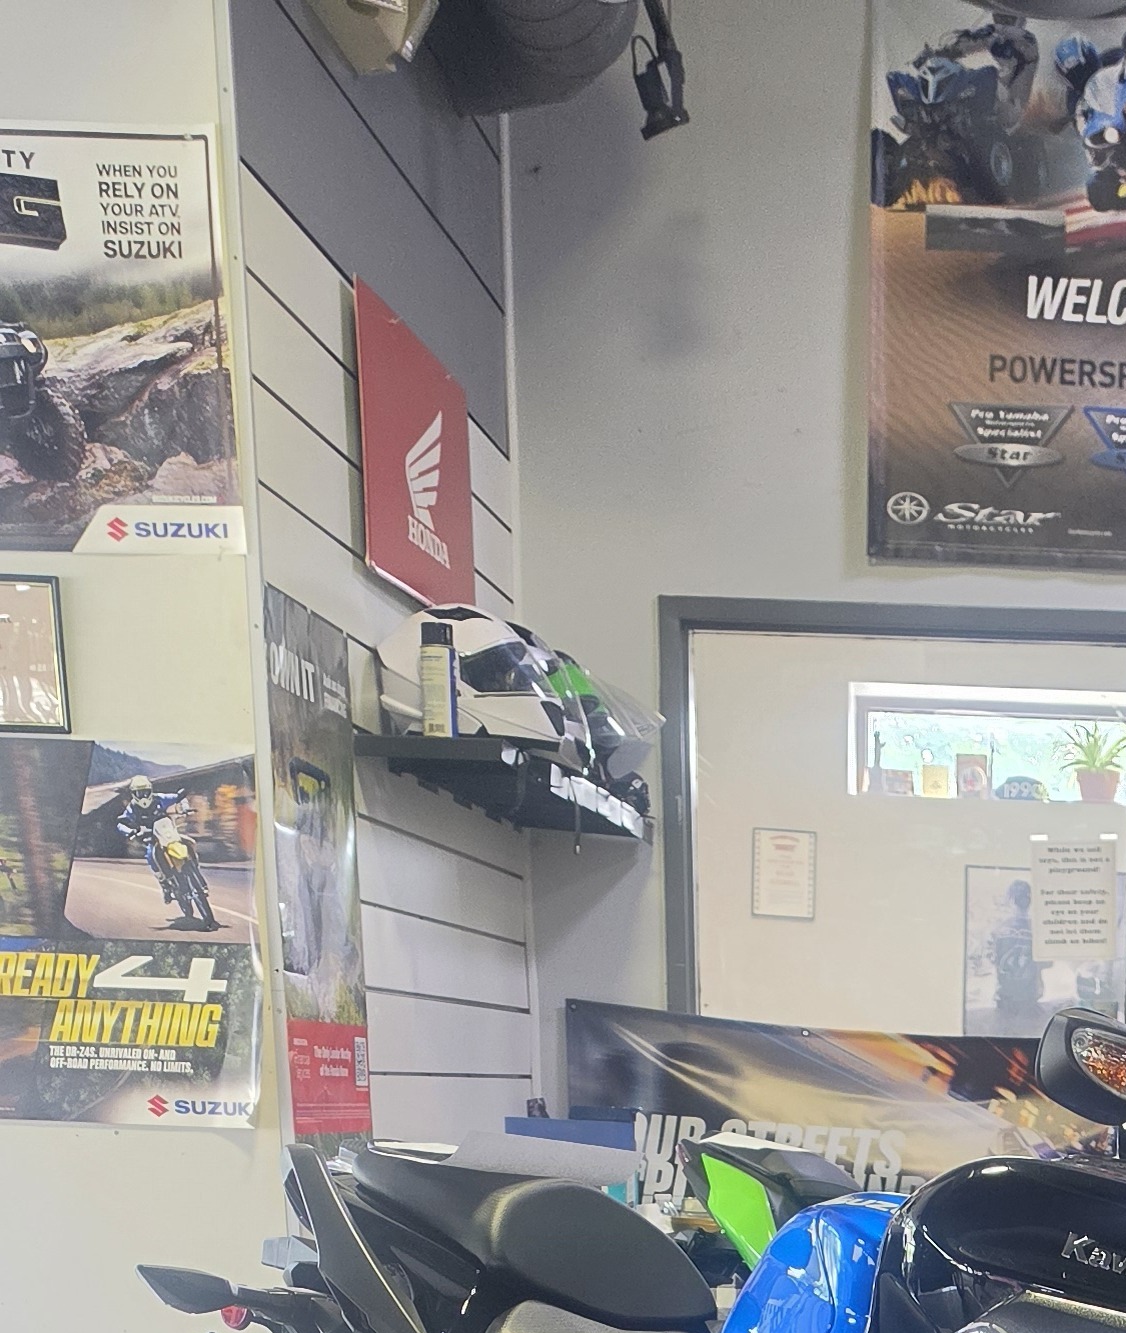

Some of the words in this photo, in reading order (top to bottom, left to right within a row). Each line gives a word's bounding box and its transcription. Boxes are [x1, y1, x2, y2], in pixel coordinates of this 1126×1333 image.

[96, 163, 142, 178] WHEN
[146, 165, 178, 178] YOU
[98, 181, 146, 199] RELY
[151, 183, 179, 199] ON
[100, 202, 145, 217] YOUR
[101, 220, 154, 236] INSIST
[158, 222, 181, 236] ON
[103, 239, 183, 260] SUZUKI
[988, 447, 1031, 462] Star
[933, 502, 1062, 526] Star
[134, 522, 228, 539] SUZUKI
[408, 514, 451, 570] HONDA
[0, 952, 100, 998] READY
[93, 955, 228, 1002] 4
[49, 1000, 223, 1048] ANYTHING
[49, 1045, 64, 1056] THE
[99, 1047, 141, 1059] UNRIVALED
[143, 1049, 158, 1060] ON-
[158, 1049, 176, 1060] AND
[50, 1057, 88, 1069] OFF-ROAD
[89, 1058, 149, 1072] PERFORMANCE.
[150, 1061, 162, 1072] NO
[163, 1061, 194, 1074] LIMITS.
[720, 1118, 906, 1177] EETS
